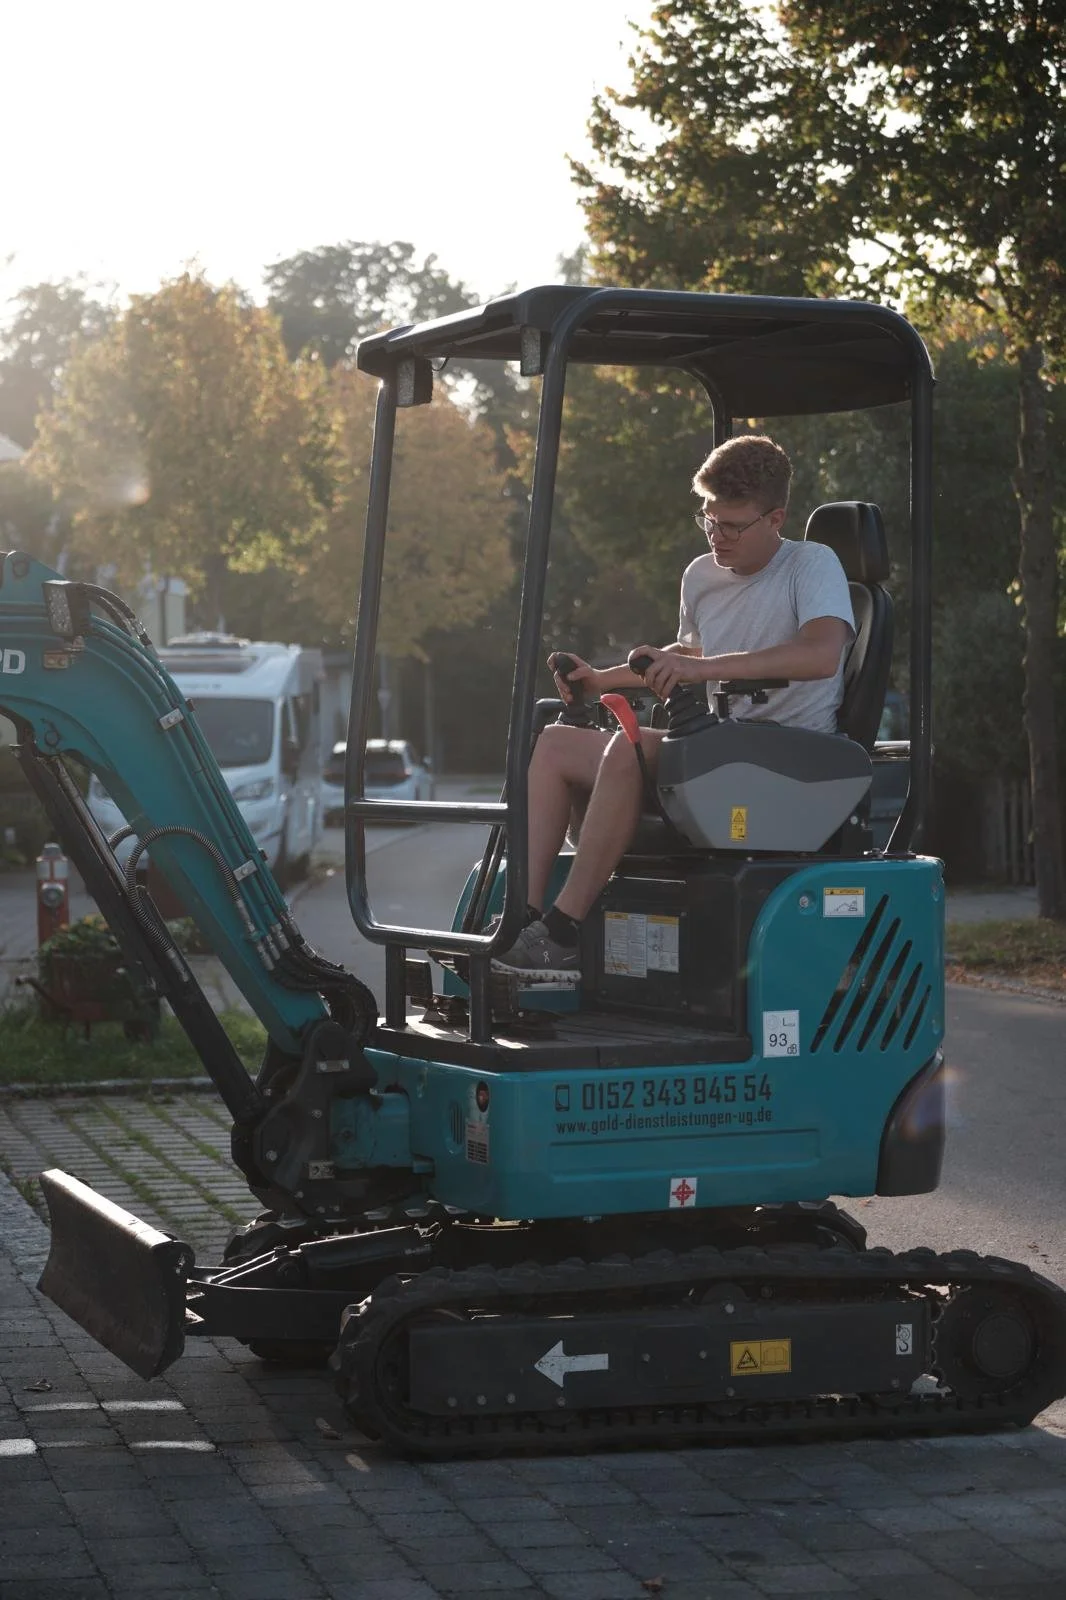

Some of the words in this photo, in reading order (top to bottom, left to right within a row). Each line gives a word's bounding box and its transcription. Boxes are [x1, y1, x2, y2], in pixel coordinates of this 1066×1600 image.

[0, 648, 26, 674] D
[769, 1033, 788, 1048] 93
[786, 1043, 798, 1055] dB
[582, 1081, 635, 1111] 0152
[642, 1078, 686, 1108] 343
[693, 1075, 737, 1105] 945
[743, 1073, 773, 1102] 54
[556, 1106, 773, 1136] www.gold-dienstleistungen-ug.de
